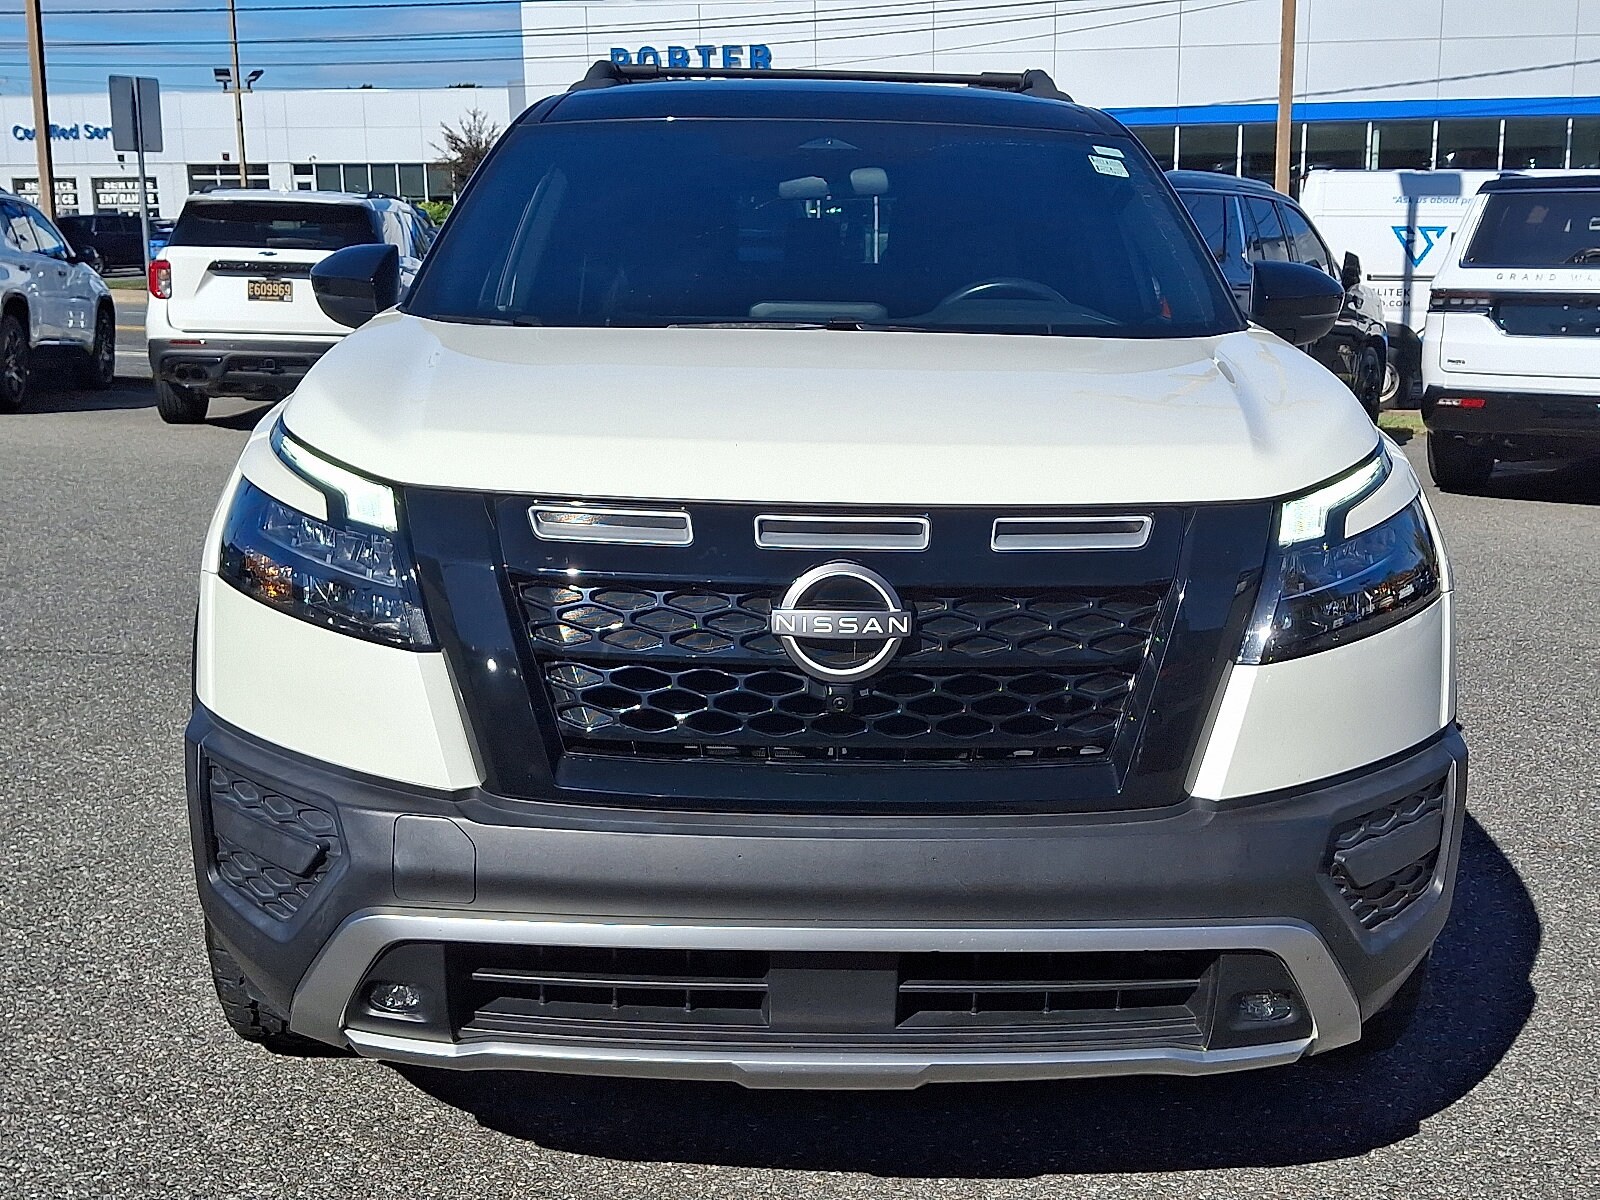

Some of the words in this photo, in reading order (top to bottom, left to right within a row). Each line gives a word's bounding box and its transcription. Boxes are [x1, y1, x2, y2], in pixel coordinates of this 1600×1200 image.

[103, 181, 154, 190] SERVIE
[99, 193, 155, 204] ENTRANE
[1496, 272, 1557, 281] GRAND
[1372, 288, 1411, 297] LITEK
[775, 614, 909, 634] NISSAN
